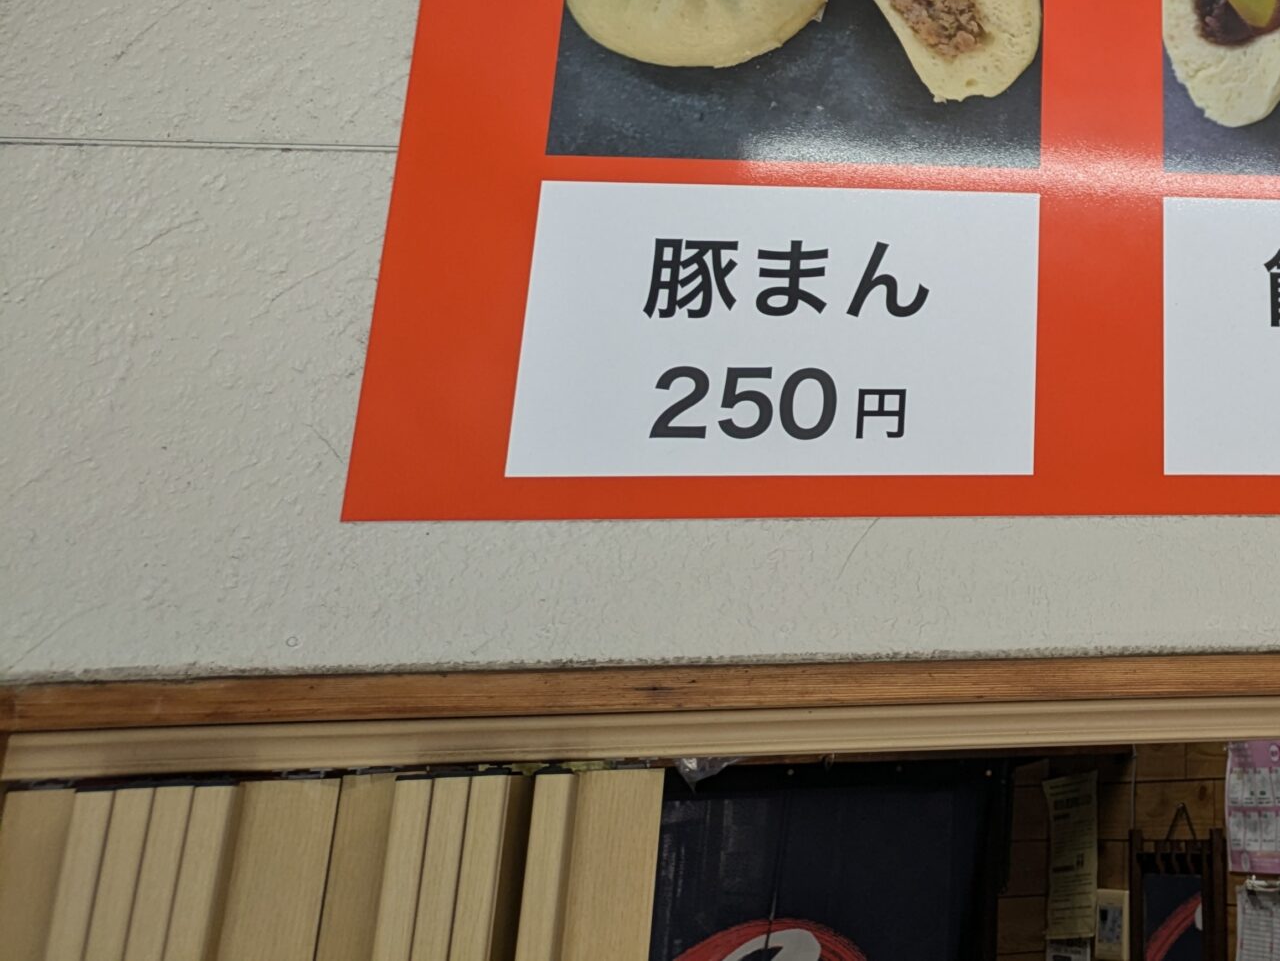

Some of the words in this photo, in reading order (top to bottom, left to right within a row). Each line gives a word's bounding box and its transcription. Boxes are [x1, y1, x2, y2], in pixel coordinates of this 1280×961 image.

[642, 237, 930, 319] 豚まん
[648, 365, 907, 441] 250円
